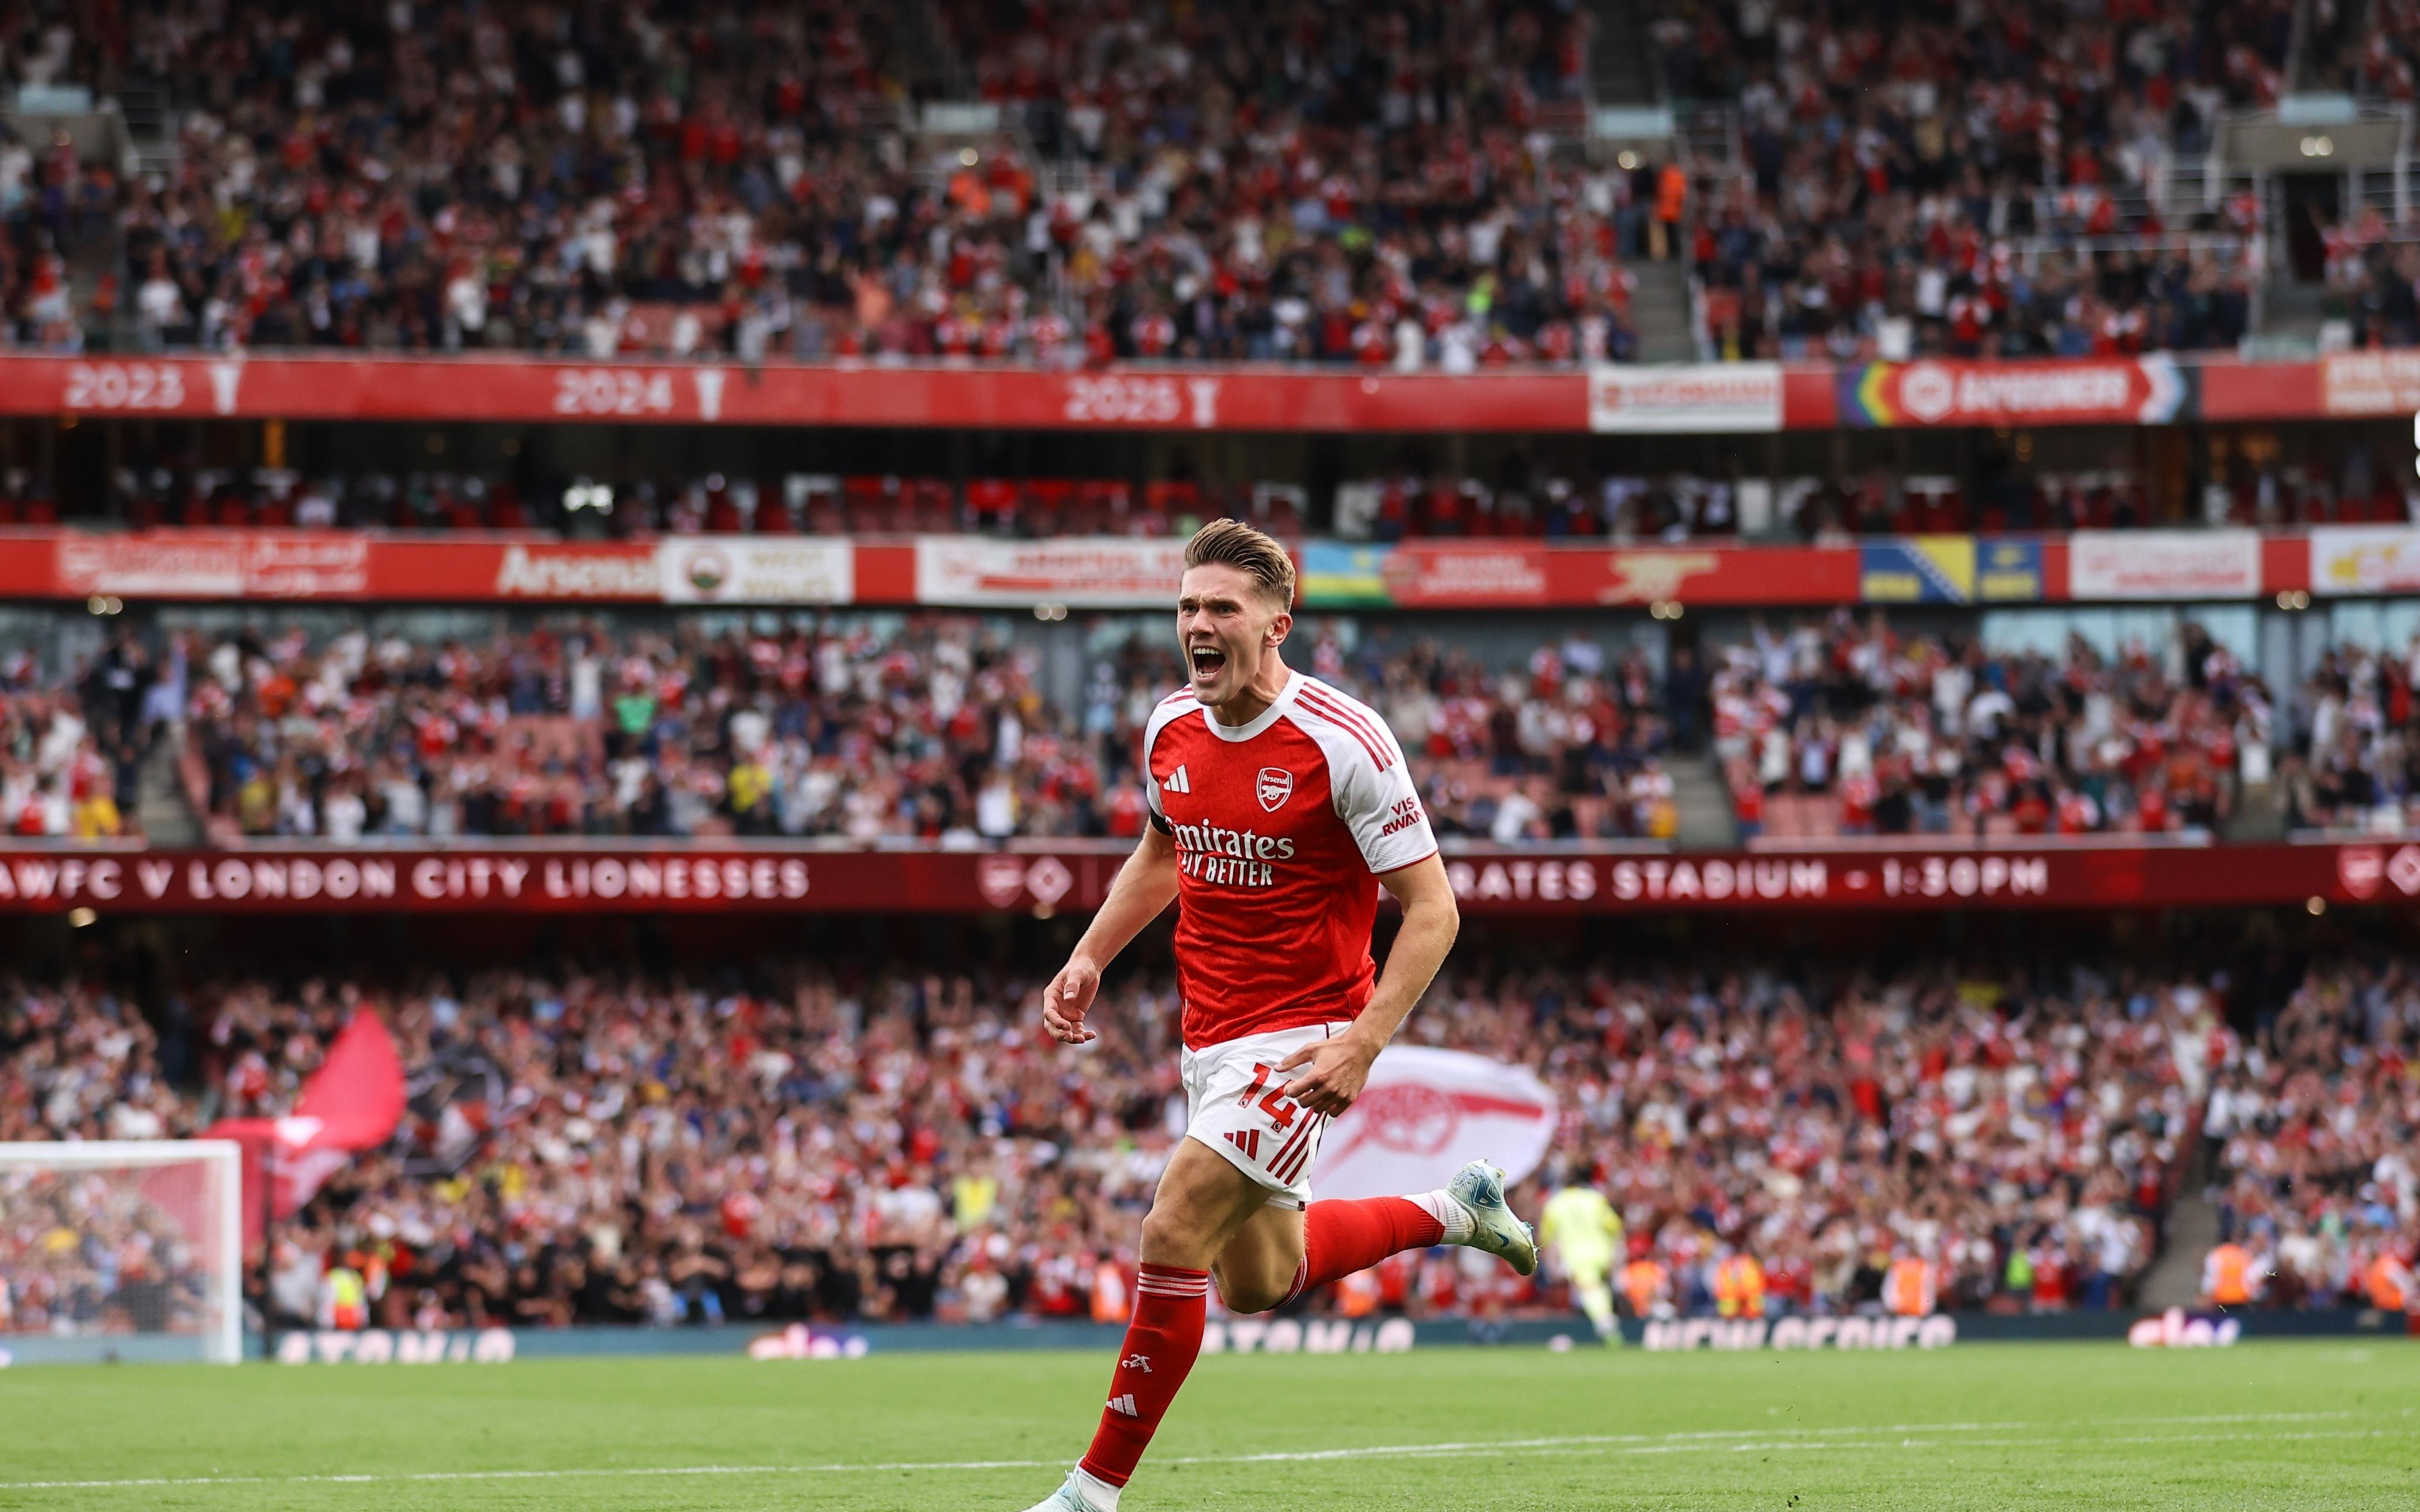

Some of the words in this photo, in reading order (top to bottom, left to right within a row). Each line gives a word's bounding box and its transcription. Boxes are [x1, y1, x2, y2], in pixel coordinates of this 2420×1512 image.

[65, 363, 185, 408] 2023
[555, 370, 673, 414] 2024
[1065, 377, 1180, 421] 2025
[1263, 774, 1287, 784] Arsenal
[1391, 797, 1414, 815] VIS
[136, 859, 174, 900] V
[188, 859, 396, 900] LONDON
[412, 858, 530, 899] CITY
[543, 858, 810, 900] LIONESSES
[1205, 857, 1272, 886] BETTER
[1449, 860, 1597, 900] RATES
[1612, 859, 1828, 900] STADIUM
[1238, 1062, 1297, 1133] 14
